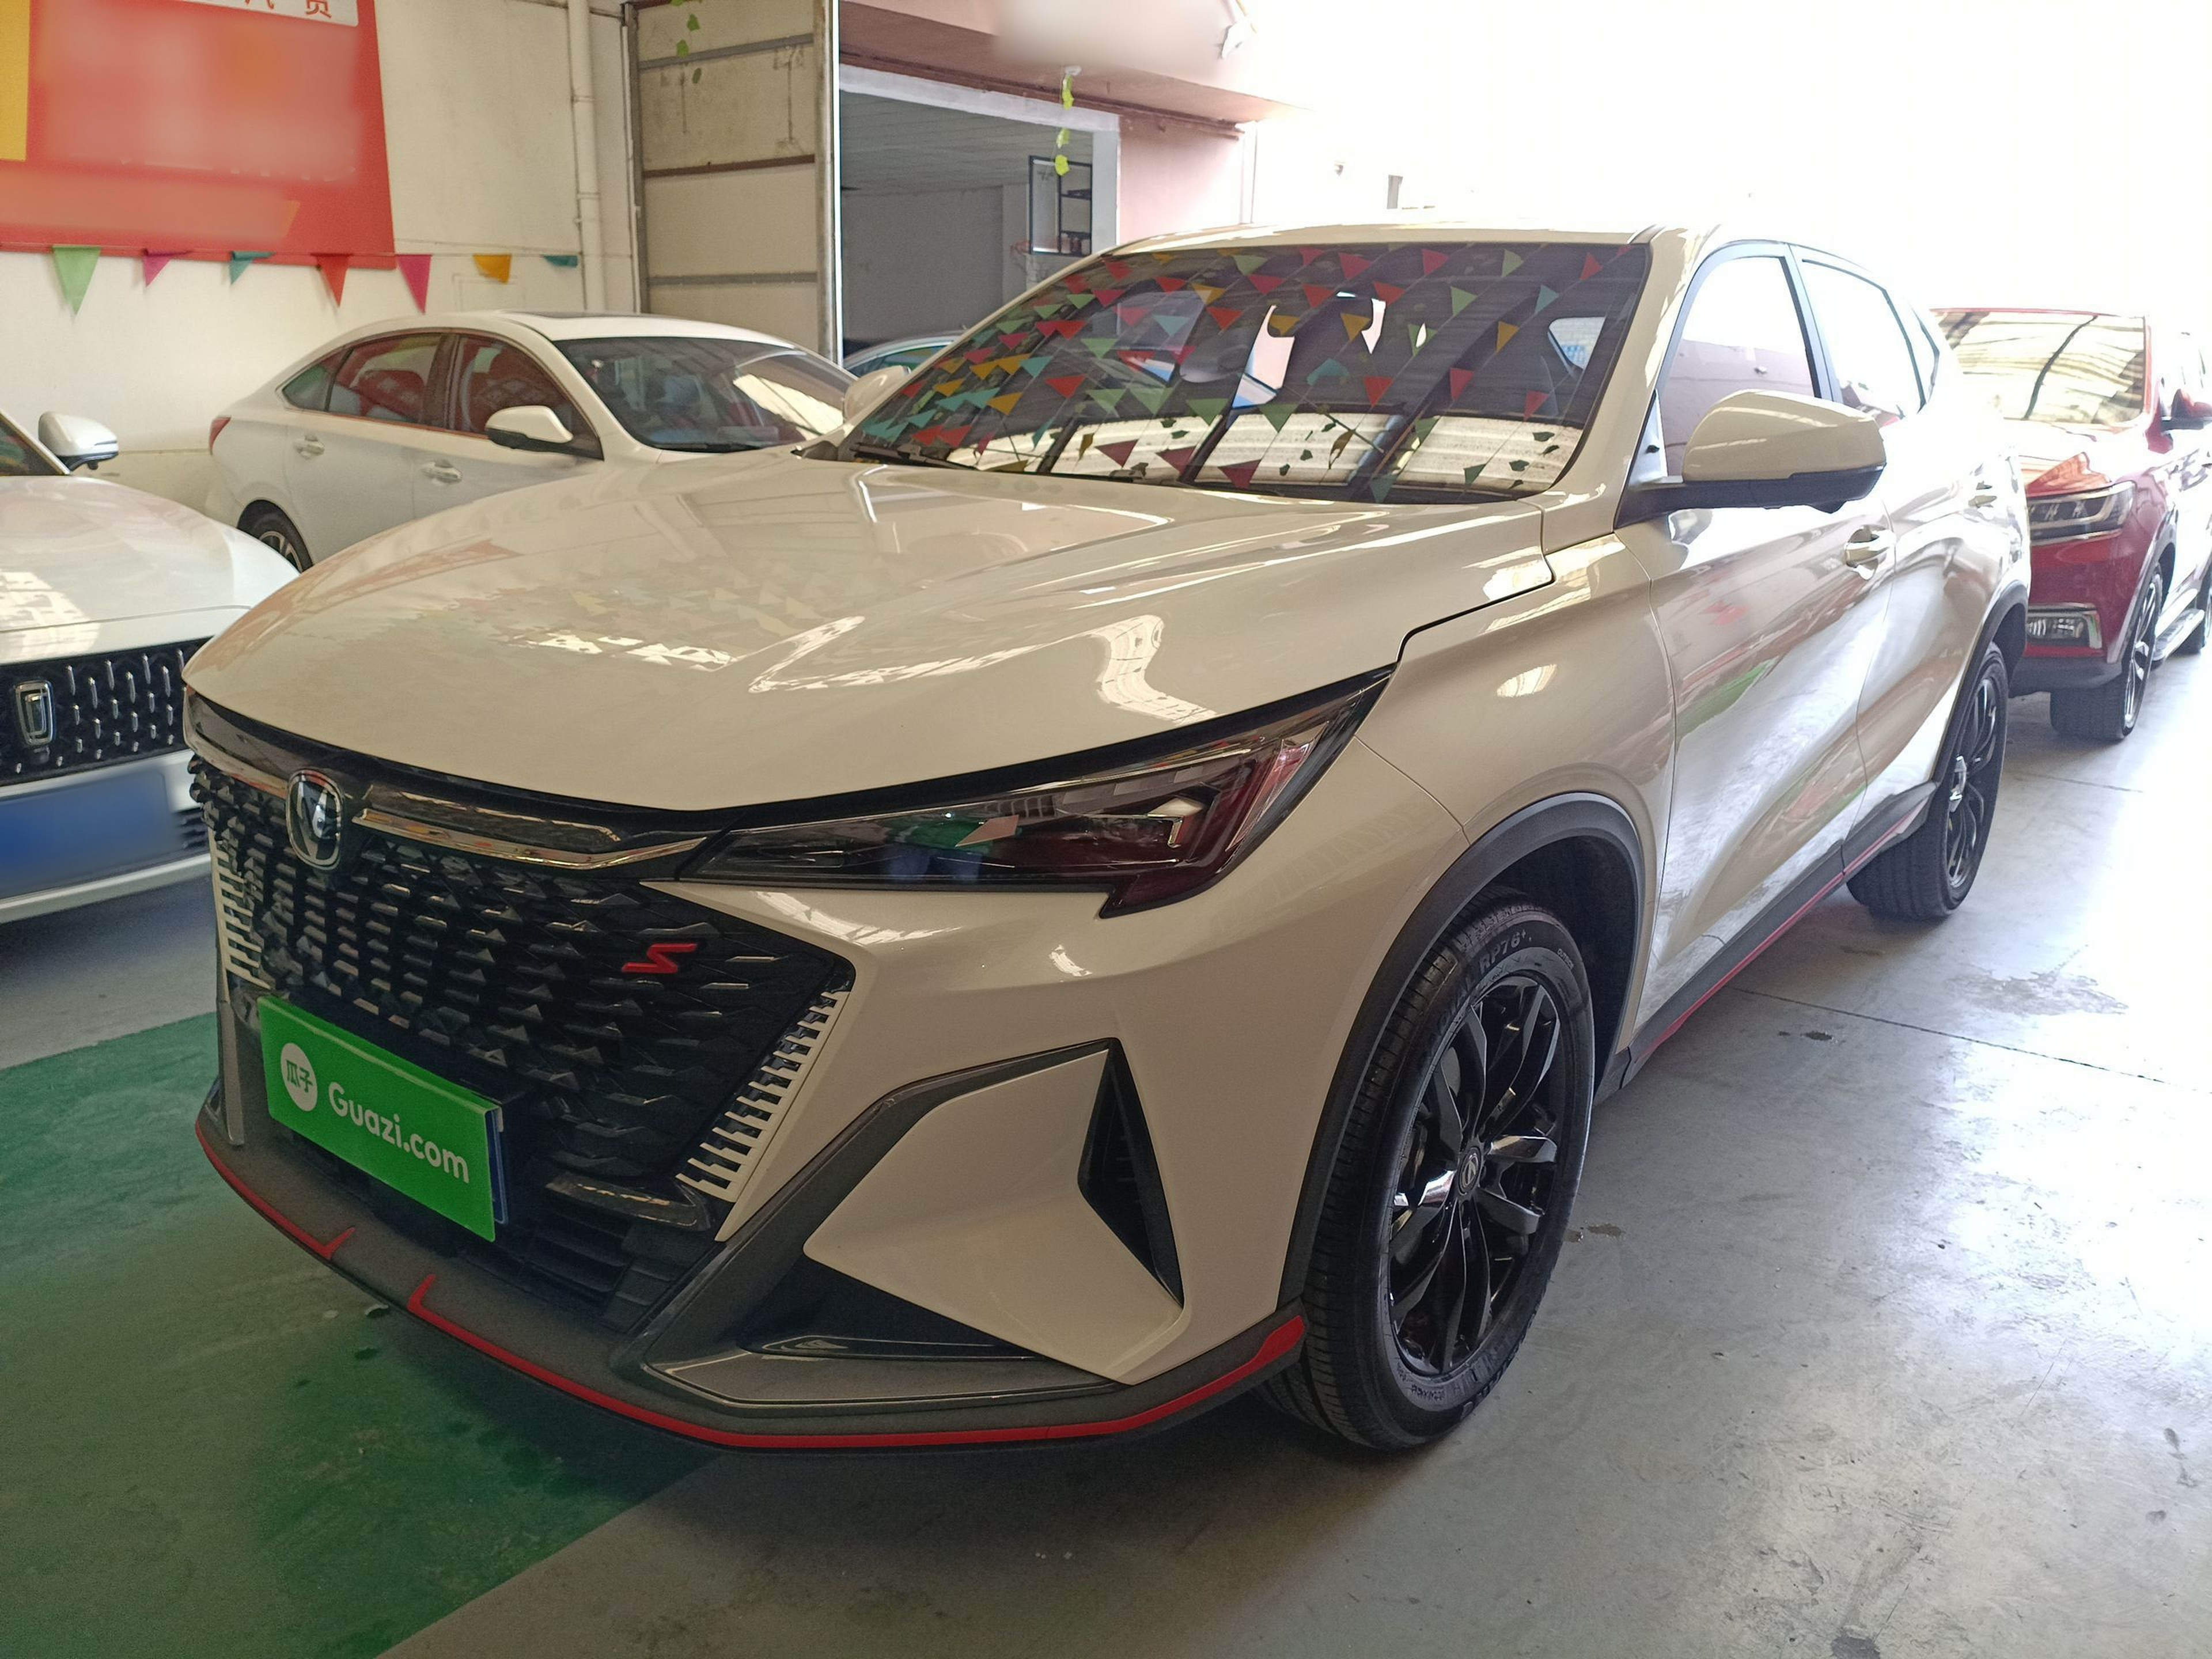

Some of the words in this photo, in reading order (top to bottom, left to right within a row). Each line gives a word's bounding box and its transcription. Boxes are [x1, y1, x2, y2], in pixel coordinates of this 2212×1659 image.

[622, 943, 697, 974] S
[286, 1059, 313, 1092] 瓜子
[328, 1082, 469, 1184] Guazi.com
